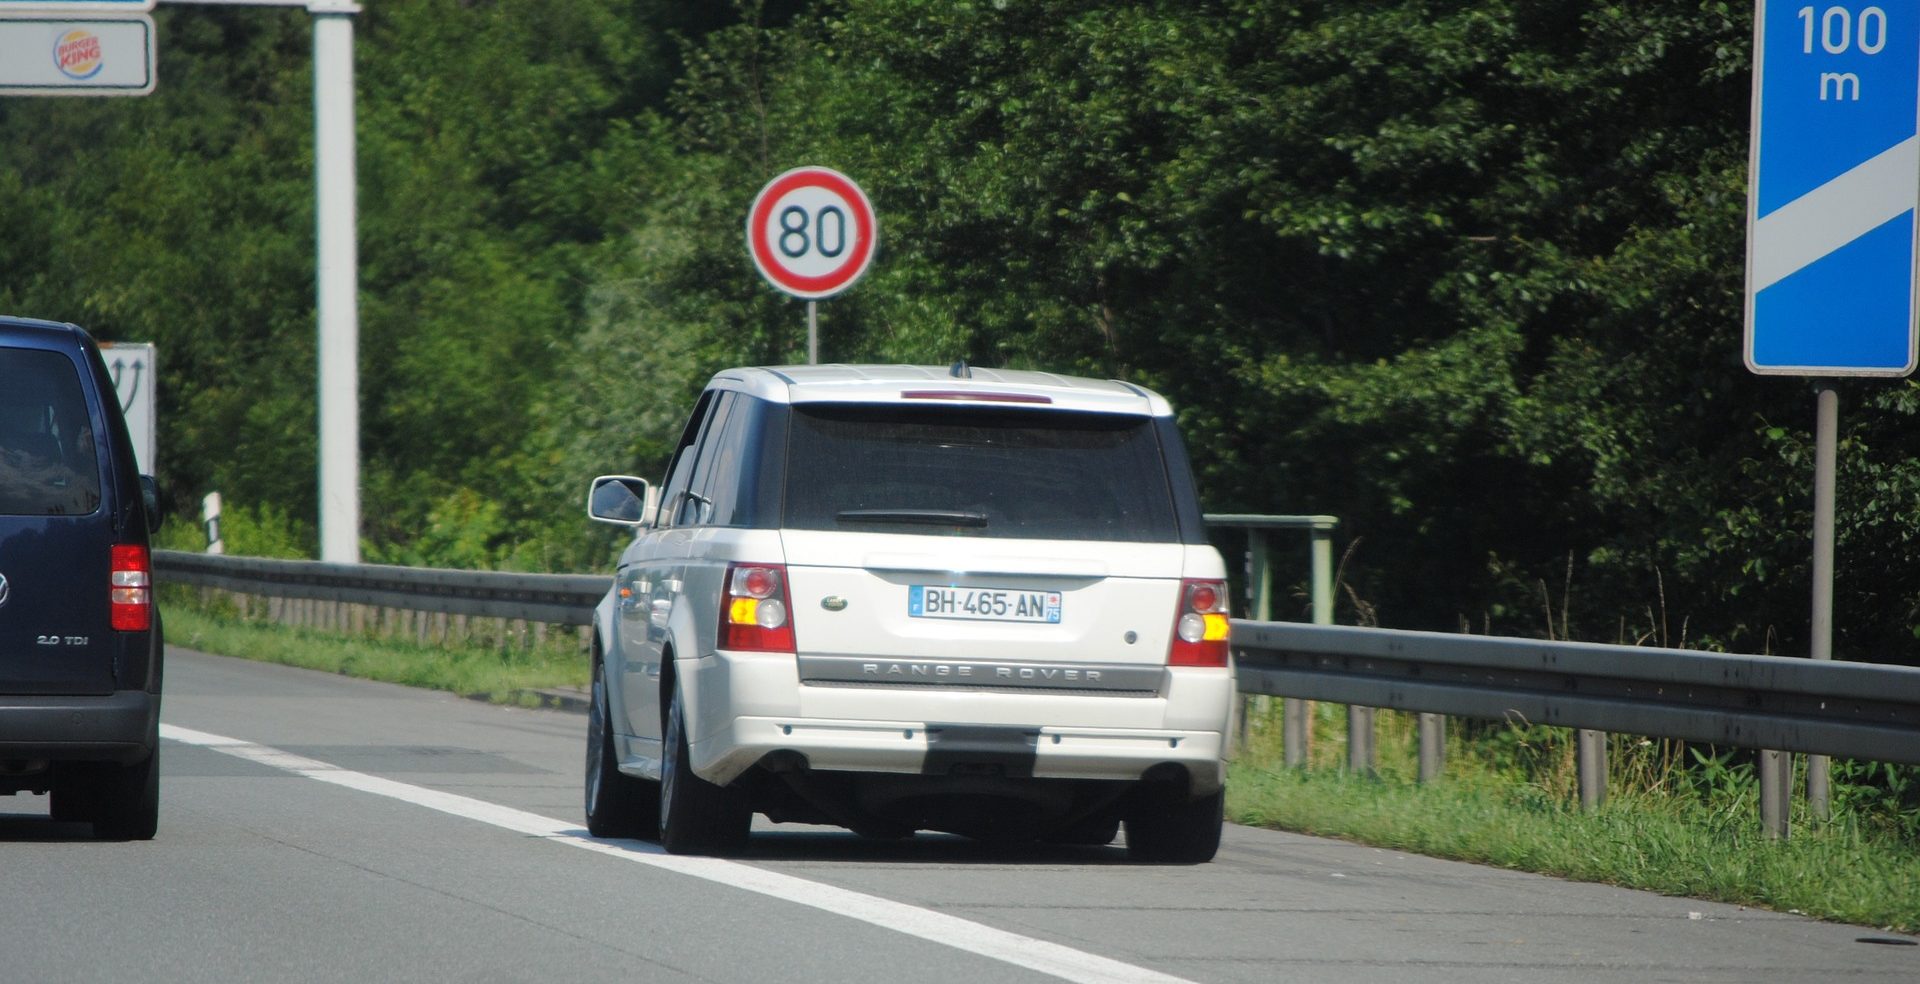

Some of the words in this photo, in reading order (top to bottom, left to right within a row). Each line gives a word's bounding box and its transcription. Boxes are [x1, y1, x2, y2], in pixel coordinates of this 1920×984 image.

[1797, 6, 1887, 55] 100
[58, 36, 99, 57] BURGER
[60, 47, 101, 69] KING
[1819, 72, 1860, 101] m
[779, 205, 846, 258] 80
[912, 603, 920, 611] F
[925, 589, 1044, 617] BH-465-AN
[1047, 607, 1060, 620] 75
[64, 636, 89, 645] TDI
[863, 663, 972, 676] RANGE
[996, 666, 1102, 682] ROVER
